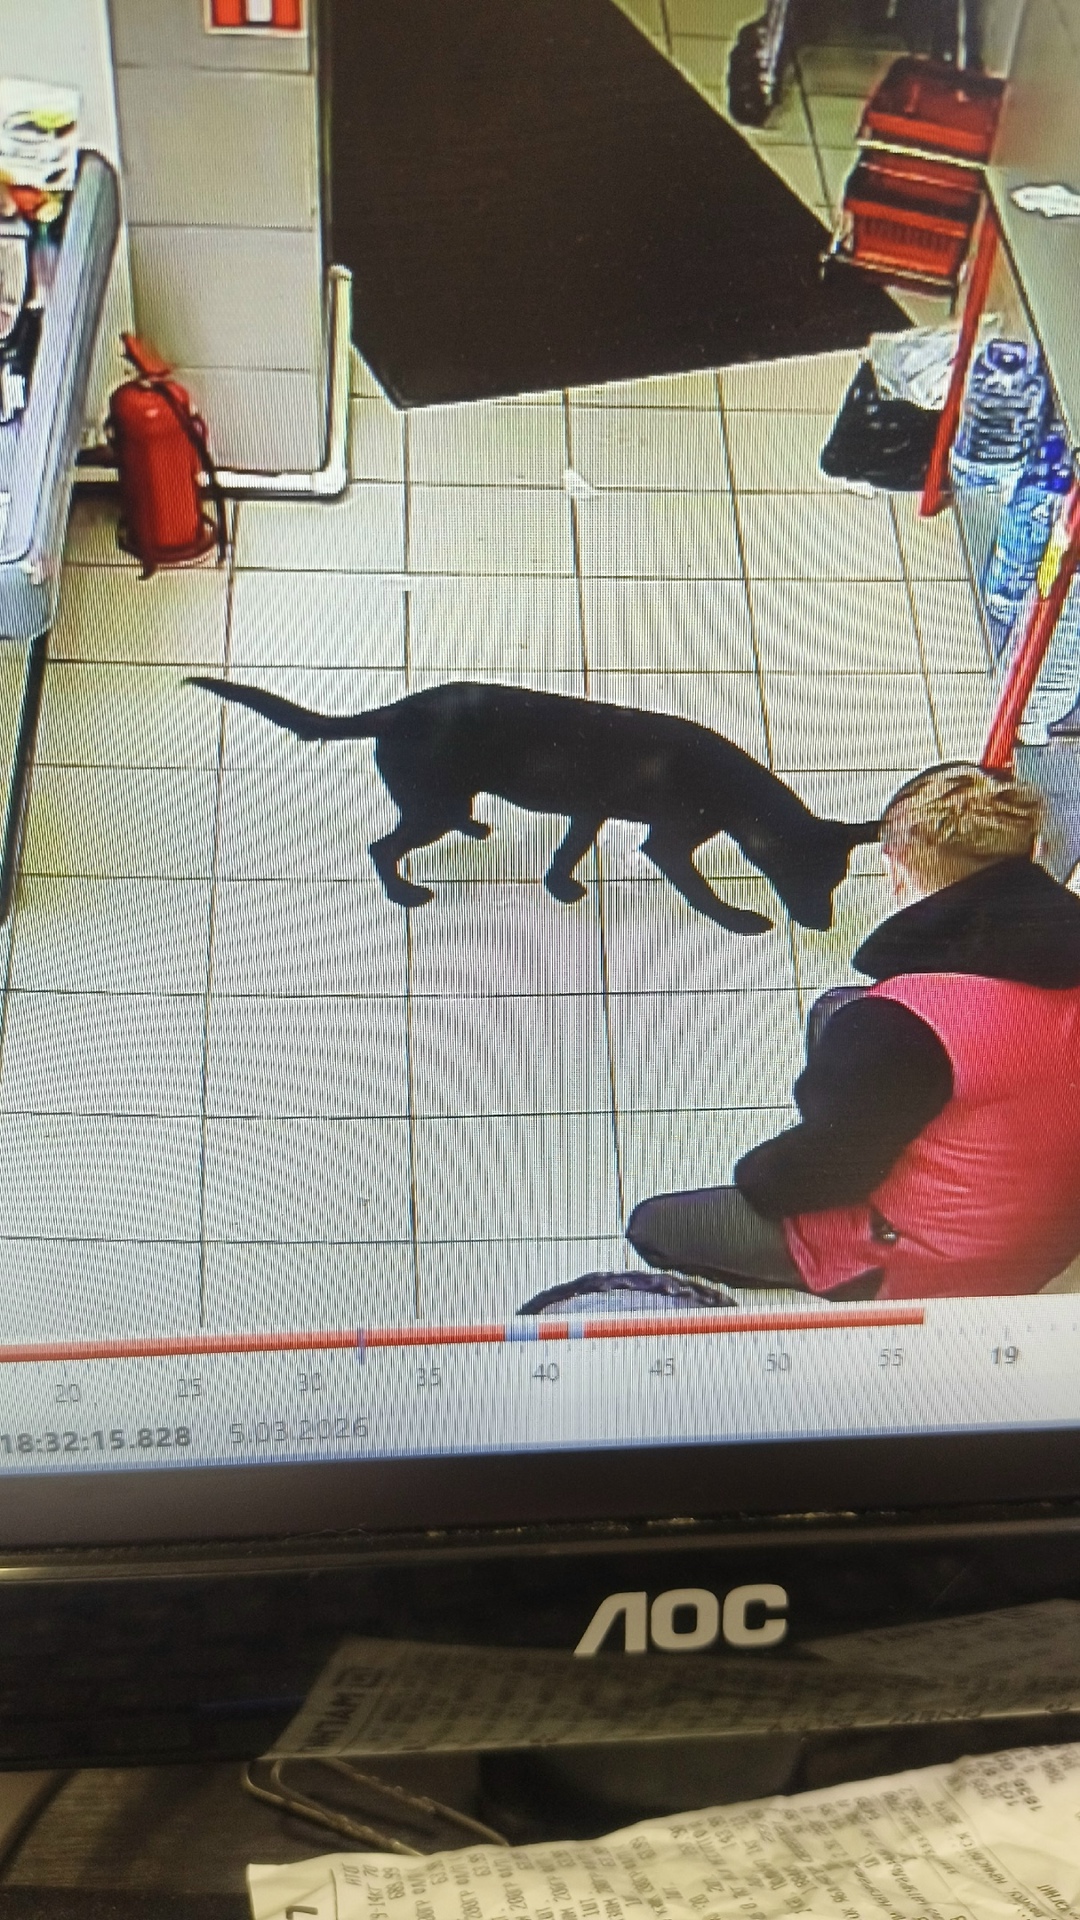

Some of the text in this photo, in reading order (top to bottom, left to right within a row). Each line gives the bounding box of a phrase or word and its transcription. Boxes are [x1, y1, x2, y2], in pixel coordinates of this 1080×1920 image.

[56, 1345, 1019, 1403] 20 25 30 35 40 45 50 55 19
[0, 1417, 369, 1454] 18:32:15.828 5.03.2026
[573, 1583, 788, 1657] AOC
